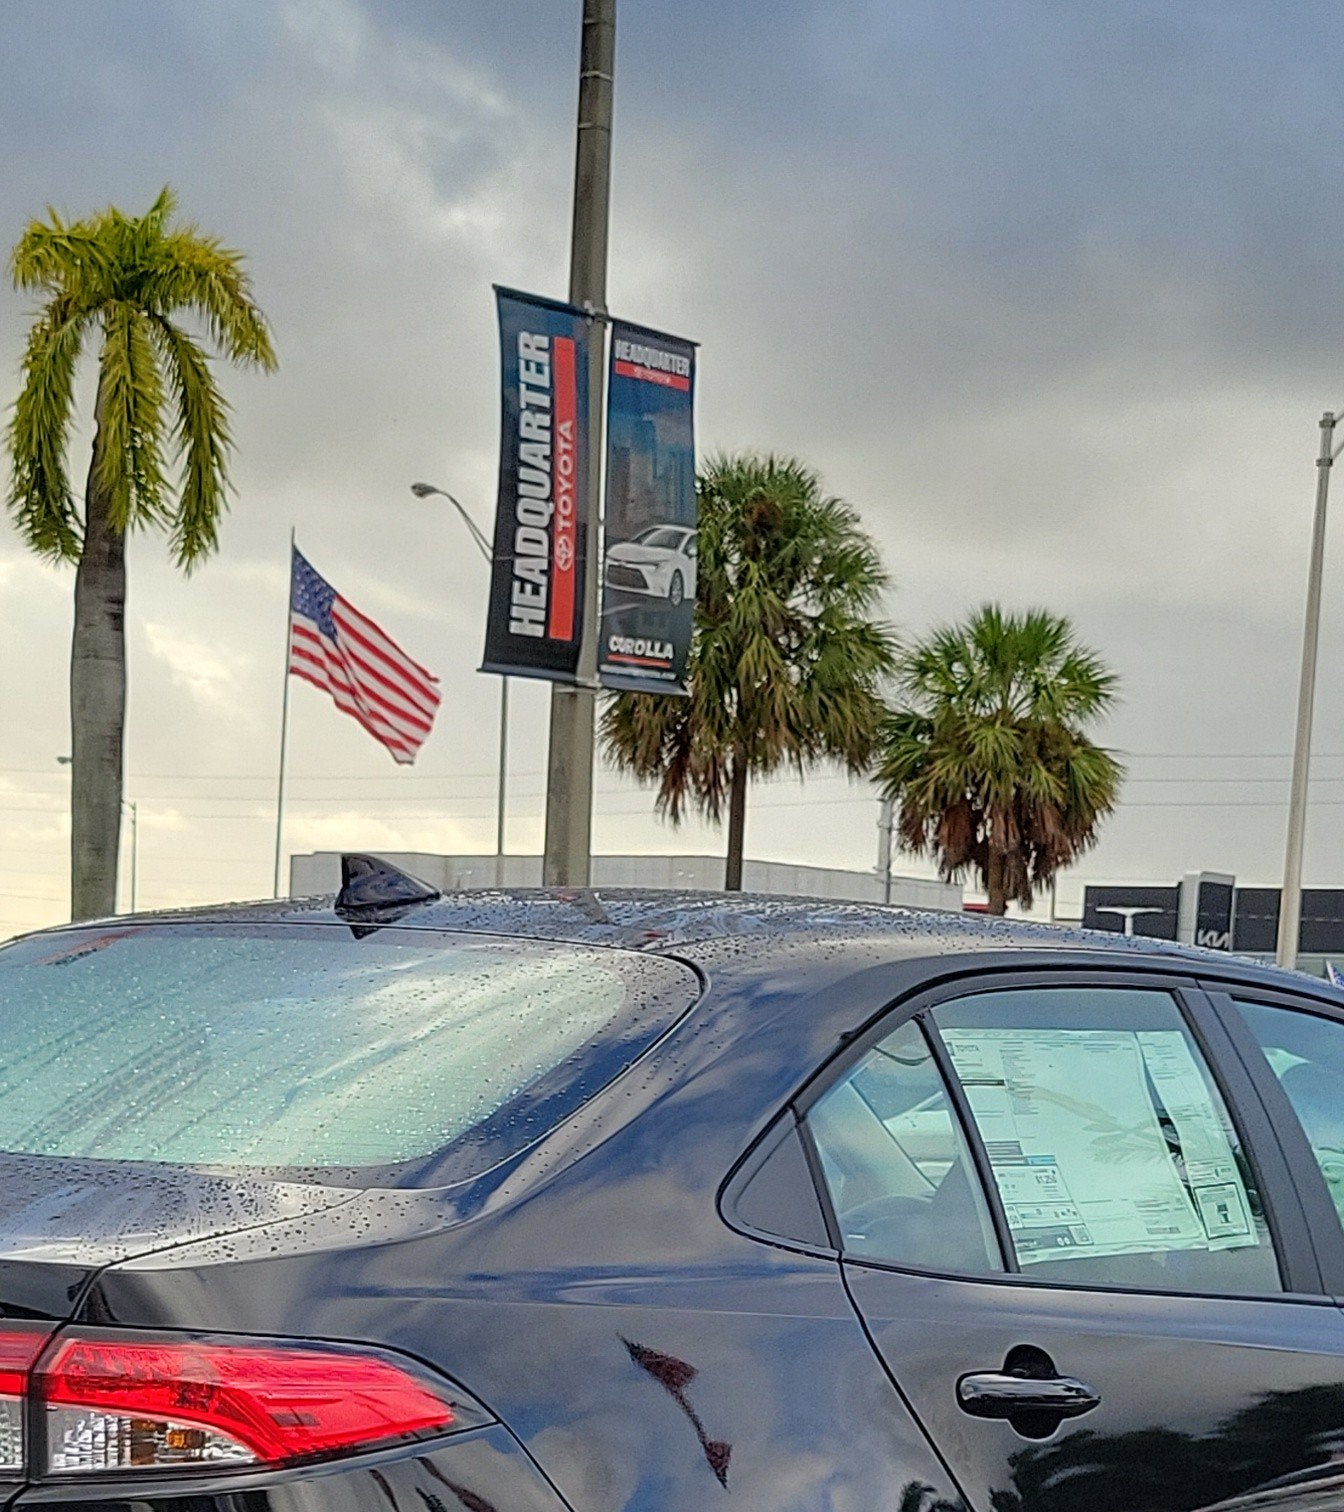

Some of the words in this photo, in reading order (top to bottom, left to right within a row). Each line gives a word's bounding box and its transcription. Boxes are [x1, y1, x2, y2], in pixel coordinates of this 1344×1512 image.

[508, 331, 554, 638] HEADQUARTER
[557, 420, 573, 532] TOYOTA
[1197, 929, 1230, 948] KIA
